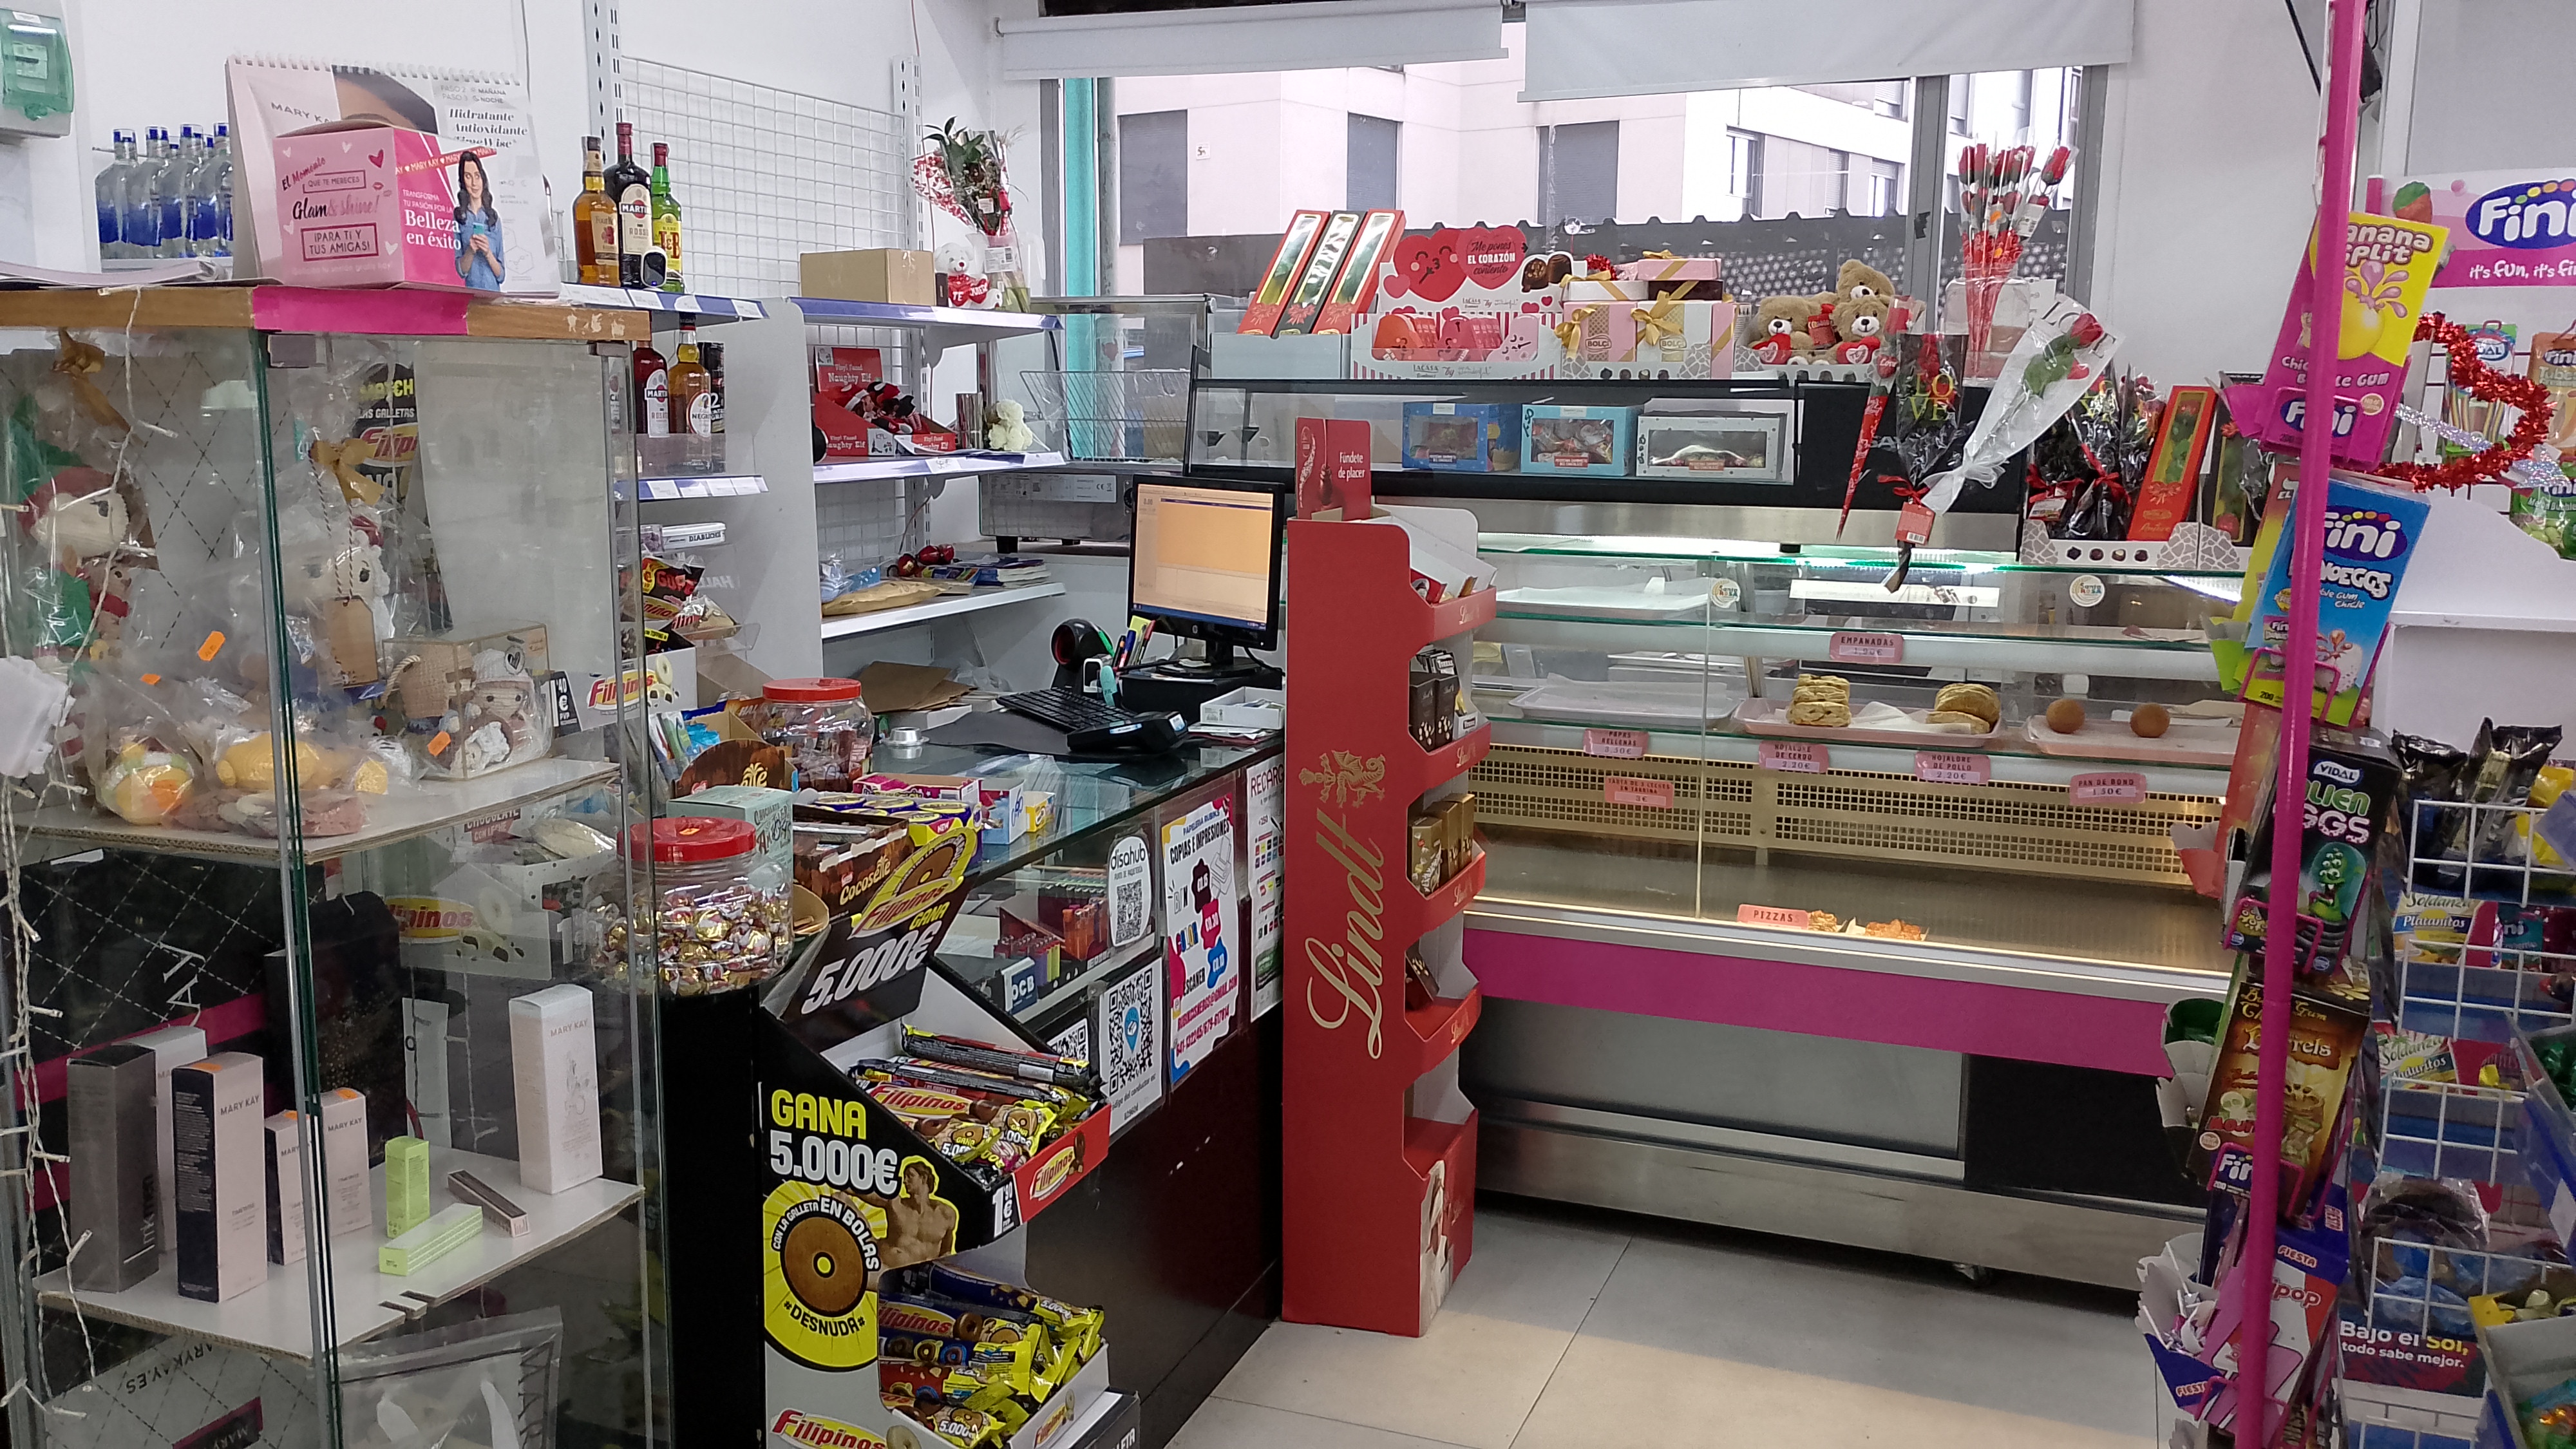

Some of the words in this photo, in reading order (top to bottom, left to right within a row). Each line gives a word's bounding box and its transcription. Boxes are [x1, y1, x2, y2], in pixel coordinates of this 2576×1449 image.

[271, 102, 310, 119] MARY
[450, 108, 514, 122] Hidratante
[455, 123, 528, 136] Antioxidante
[308, 179, 321, 188] QUE
[292, 197, 328, 220] Glam
[404, 209, 460, 233] Belleza
[344, 230, 352, 240] TI
[355, 229, 362, 240] Y
[406, 232, 424, 245] en
[428, 231, 462, 250] éxito
[309, 243, 326, 255] TUS
[1472, 242, 1486, 252] Me
[1488, 243, 1511, 254] pones
[1468, 255, 1476, 265] EL
[1478, 251, 1515, 264] CORAZÓN
[1473, 265, 1508, 275] contento
[952, 290, 965, 303] TE
[828, 372, 859, 385] Naughty
[860, 372, 872, 383] Elf
[855, 440, 866, 449] Elf
[1340, 451, 1364, 464] Fúndete
[1338, 466, 1345, 478] de
[1346, 466, 1365, 482] placer
[1841, 636, 1895, 647] EMPANADAS
[1788, 752, 1813, 761] CERDO
[1931, 754, 1972, 763] HOJALDRE
[1945, 762, 1972, 772] POLLO
[2319, 762, 2357, 783] VIDAL
[937, 822, 950, 834] NEW
[1170, 840, 1191, 865] COPIAS
[1192, 839, 1196, 853] E
[1196, 817, 1230, 851] IMPRESIONES
[1110, 842, 1146, 870] disahub
[909, 902, 951, 931] GANA
[1753, 909, 1794, 923] PIZZAS
[2403, 914, 2466, 929] Platanitos
[1305, 806, 1385, 1060] Lindt
[801, 920, 943, 1014] 5.000€
[1011, 975, 1036, 1001] OCB
[550, 1023, 572, 1037] MARY
[574, 1018, 588, 1029] KAY
[220, 1101, 244, 1116] MARY
[245, 1095, 260, 1108] KAY
[871, 1084, 967, 1112] Filipinos
[772, 1089, 867, 1140] GANA
[327, 1121, 348, 1132] MARY
[349, 1117, 363, 1127] KAY
[281, 1146, 300, 1157] MARY
[770, 1130, 898, 1195] 5.000€
[1030, 1146, 1075, 1200] Filipinos
[773, 1231, 784, 1250] CON
[781, 1218, 790, 1232] LA
[786, 1202, 819, 1222] GALLETA
[820, 1197, 843, 1218] EN
[842, 1209, 880, 1270] BOLAS
[2277, 1245, 2318, 1269] FIESTA
[2342, 1341, 2376, 1356] todo
[2378, 1347, 2414, 1361] sabe
[2417, 1353, 2465, 1368] mejor.
[772, 1410, 886, 1449] Filipinos
